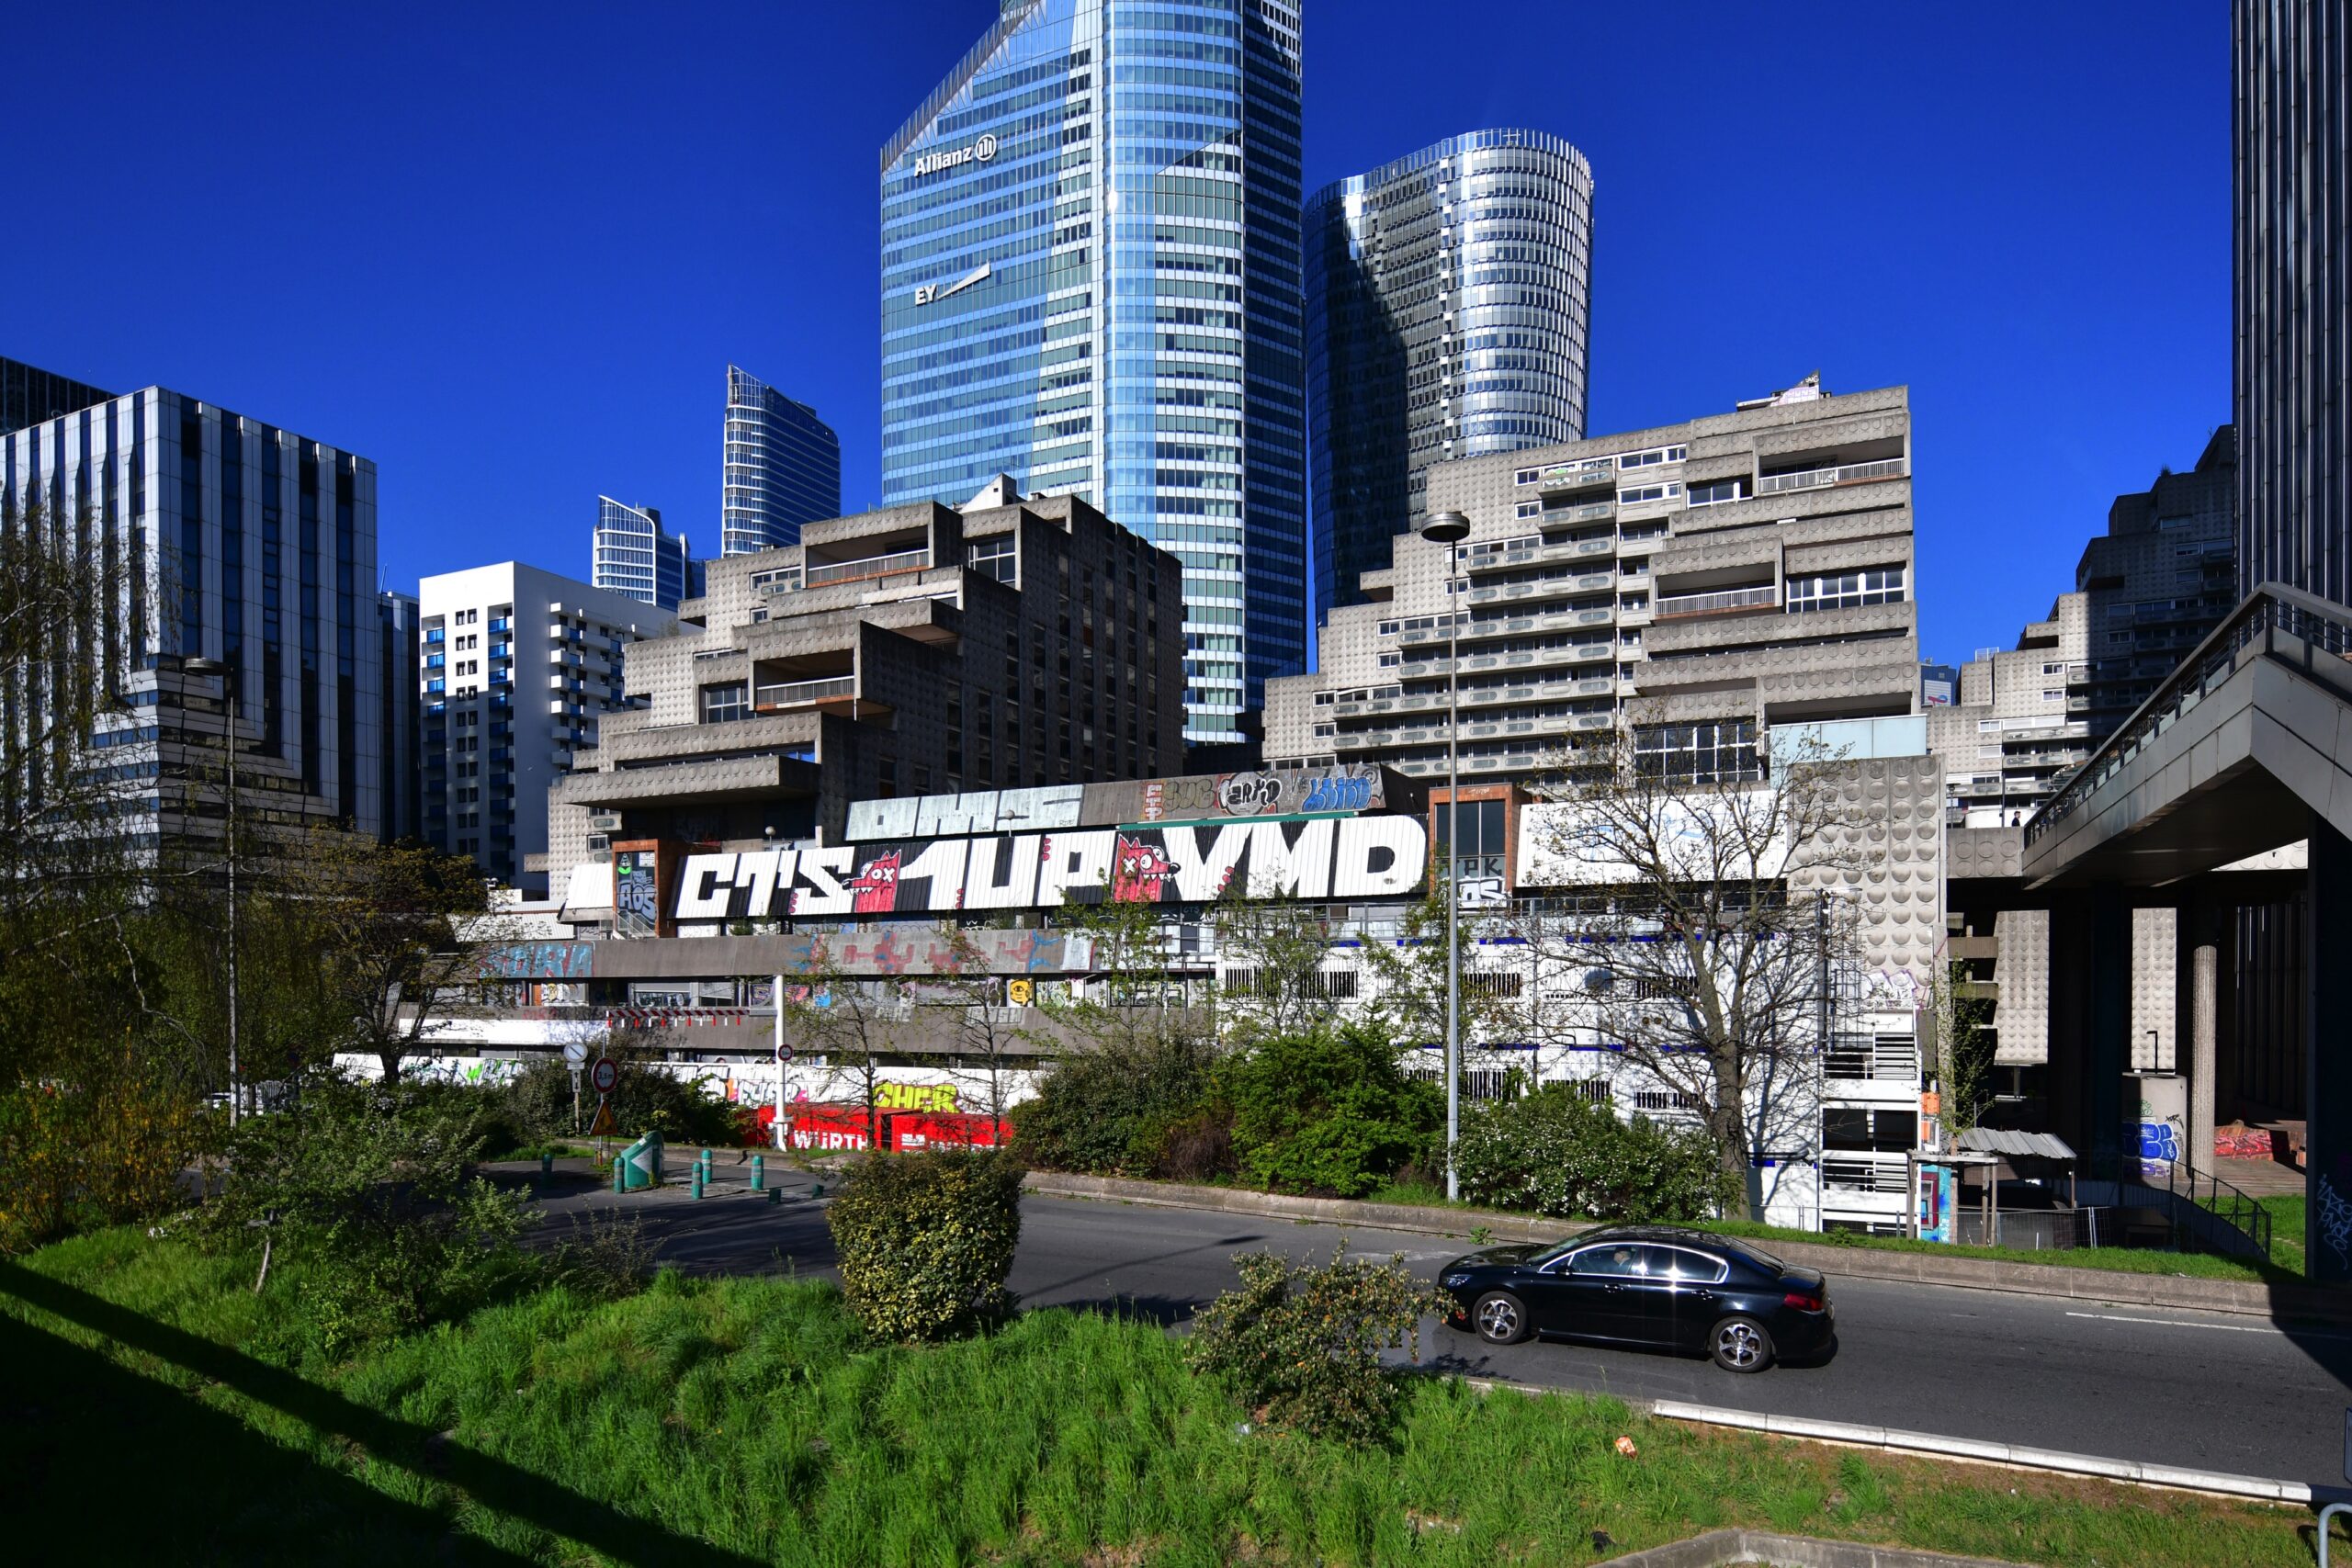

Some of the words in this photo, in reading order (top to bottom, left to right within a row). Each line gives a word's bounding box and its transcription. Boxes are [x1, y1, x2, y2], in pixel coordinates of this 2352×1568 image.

[914, 147, 973, 176] Allianz
[915, 283, 937, 305] EY
[675, 846, 856, 919] CTS
[899, 829, 1118, 910] 1UP
[1162, 815, 1426, 900] VMD
[617, 881, 658, 924] AOS
